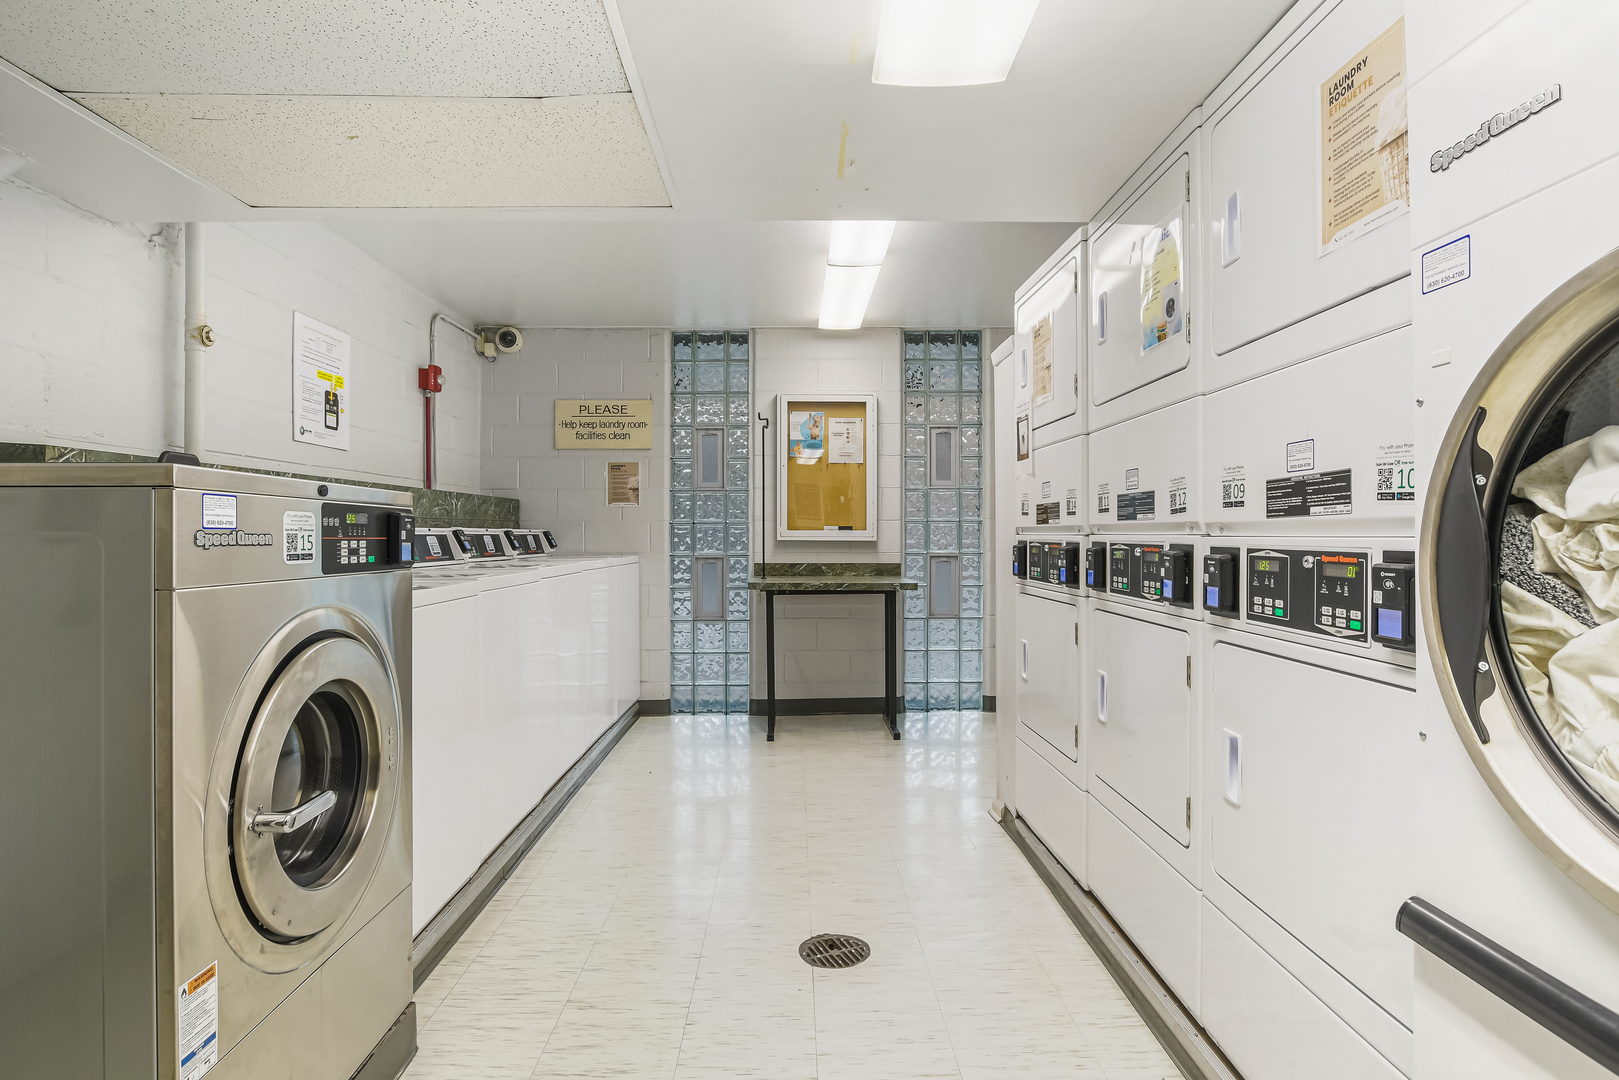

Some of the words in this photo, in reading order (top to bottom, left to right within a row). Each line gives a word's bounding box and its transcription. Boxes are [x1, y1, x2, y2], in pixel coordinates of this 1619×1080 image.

[1328, 56, 1368, 96] LAUNDRY
[1328, 80, 1354, 106] ROOM
[1329, 75, 1374, 117] ETIQUETTE
[1430, 120, 1490, 172] Speed
[1489, 84, 1562, 137] Queen
[1427, 279, 1440, 290] (630)
[1441, 270, 1464, 284] 620-4700
[579, 405, 628, 414] PLEASE
[562, 420, 577, 430] Help
[579, 420, 597, 430] keep
[599, 420, 626, 430] laundry
[576, 431, 606, 440] facilities
[608, 431, 631, 440] clean
[1398, 468, 1414, 489] 10
[1178, 492, 1186, 506] 12
[1233, 484, 1245, 499] 09
[1104, 496, 1109, 507] 11
[194, 530, 237, 550] Speed
[237, 530, 273, 546] Queen
[301, 535, 313, 550] 15
[1321, 555, 1338, 563] Speed
